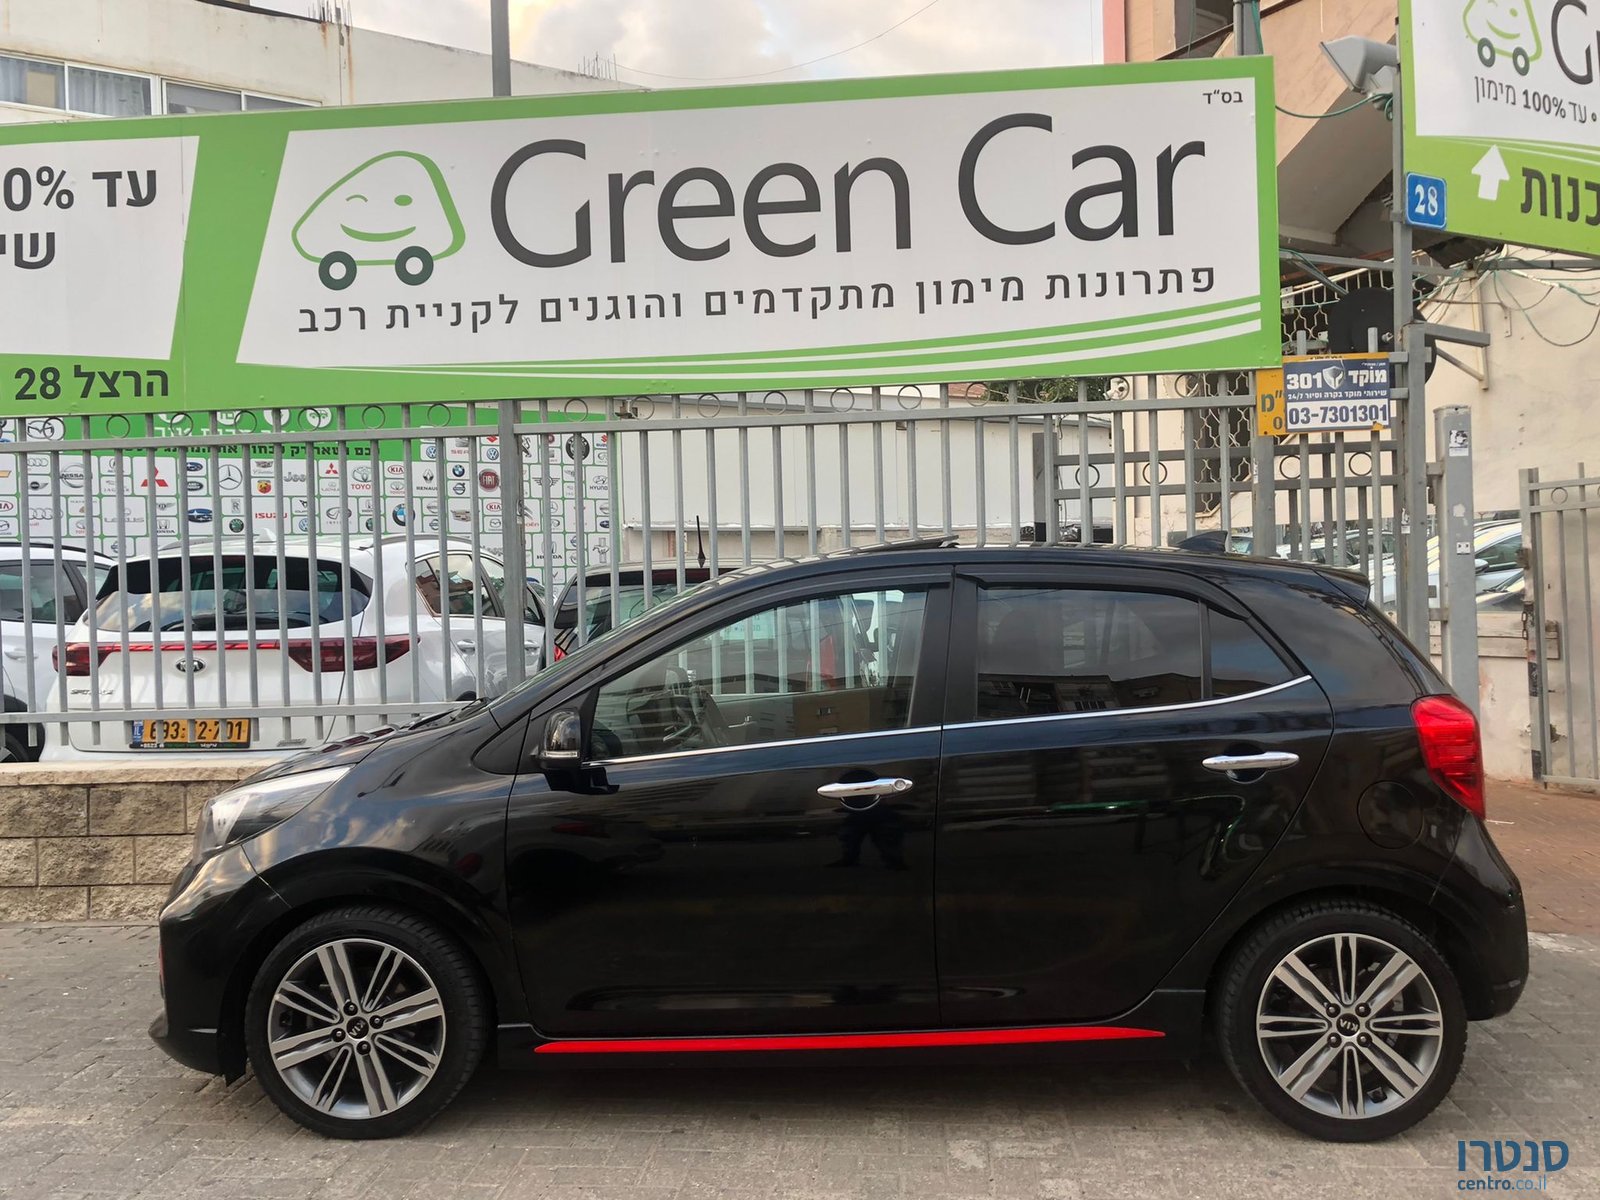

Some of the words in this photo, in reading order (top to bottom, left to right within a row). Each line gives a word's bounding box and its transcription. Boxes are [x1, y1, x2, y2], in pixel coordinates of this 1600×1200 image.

[1552, 0, 1600, 85] G
[1474, 76, 1516, 105] מימון
[1522, 89, 1566, 119] 100%
[1568, 102, 1587, 124] עד
[92, 169, 157, 208] עד
[490, 139, 912, 268] Green
[958, 112, 1206, 246] Car
[1414, 183, 1439, 217] 28
[915, 276, 1024, 315] מימון
[1045, 267, 1214, 300] פתרונות
[385, 293, 519, 334] לקניית
[540, 293, 682, 323] והוגנים
[705, 283, 894, 320] מתקדמים
[298, 306, 366, 333] רכב
[14, 366, 61, 401] 28
[73, 364, 169, 399] הרצל
[1286, 372, 1323, 390] 301
[1323, 391, 1343, 399] בקרה
[1287, 392, 1303, 400] 24/7
[1288, 404, 1388, 425] 03-7301301
[60, 472, 87, 480] NISSA
[283, 471, 308, 483] Jee
[351, 483, 372, 491] TOYO
[482, 475, 495, 486] FIAT
[349, 1019, 367, 1036] KIA
[1339, 1018, 1359, 1032] KIA
